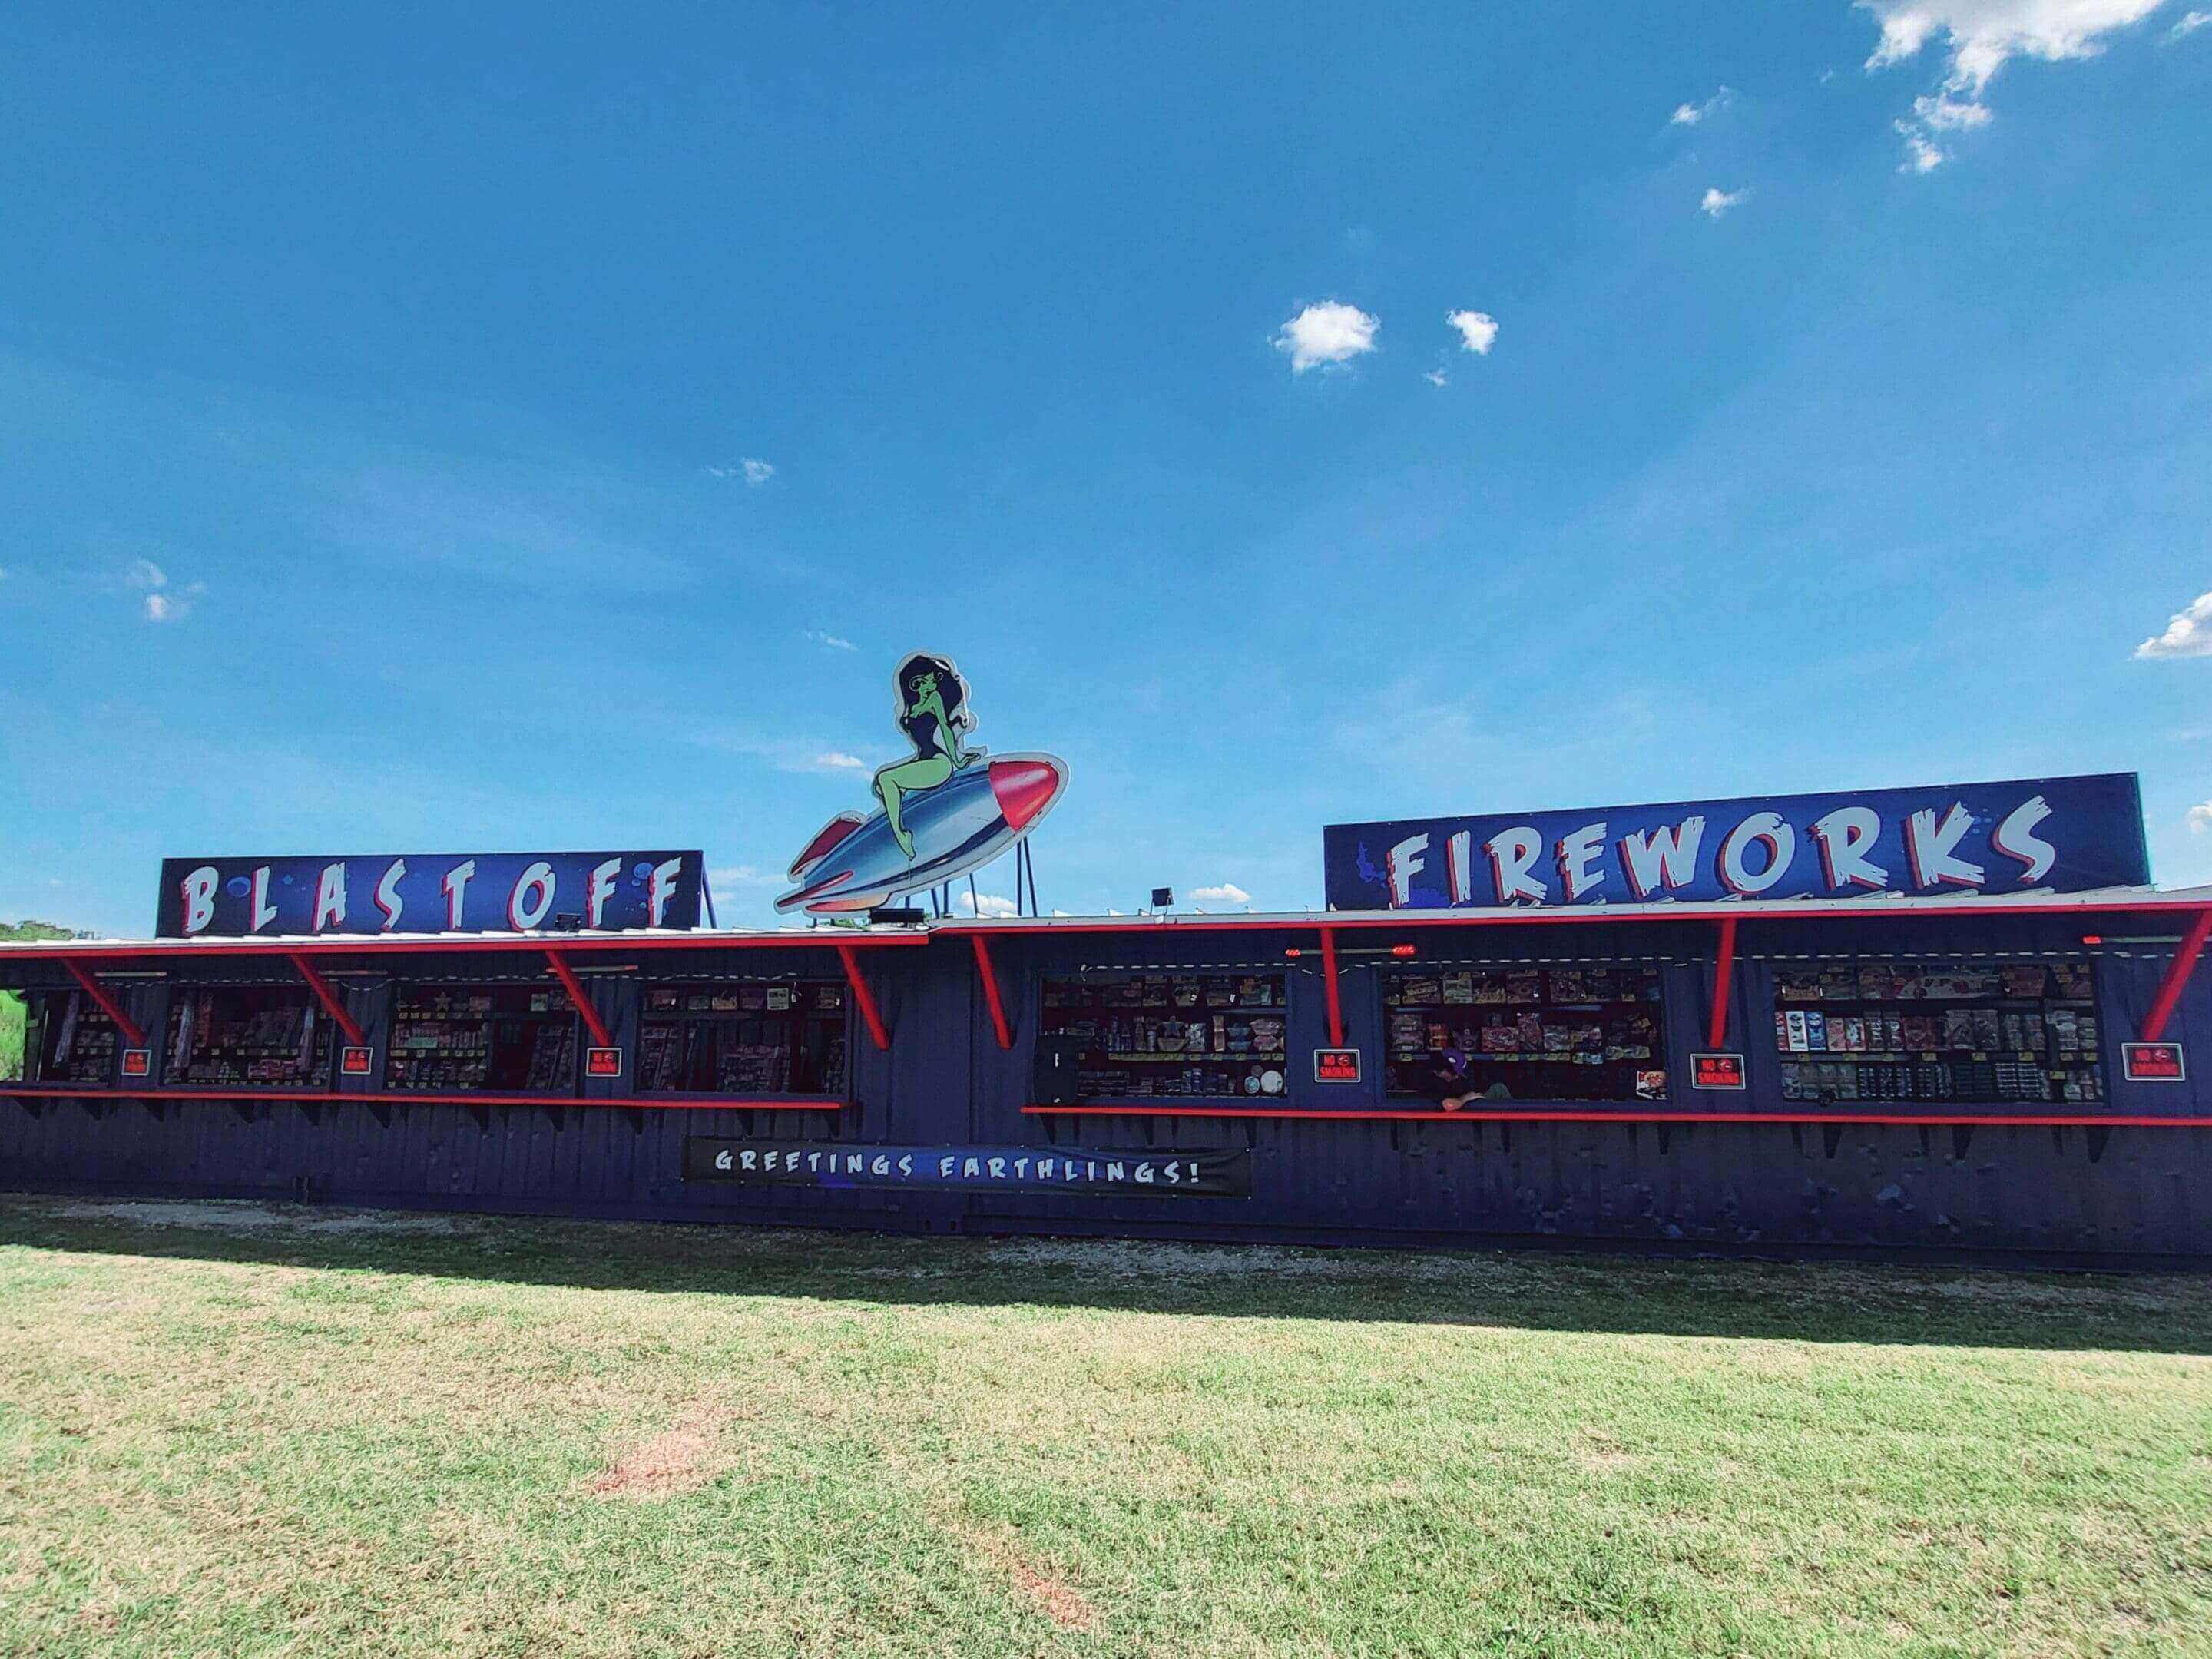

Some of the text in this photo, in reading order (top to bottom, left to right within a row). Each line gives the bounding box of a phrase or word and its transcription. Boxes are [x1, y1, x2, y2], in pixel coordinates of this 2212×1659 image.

[1388, 796, 2056, 909] FIREWORKS
[1323, 1055, 1335, 1065] NO
[1320, 1066, 1356, 1078] SMOKING
[715, 1150, 1200, 1184] GREETINGS EARTHLINGS!
